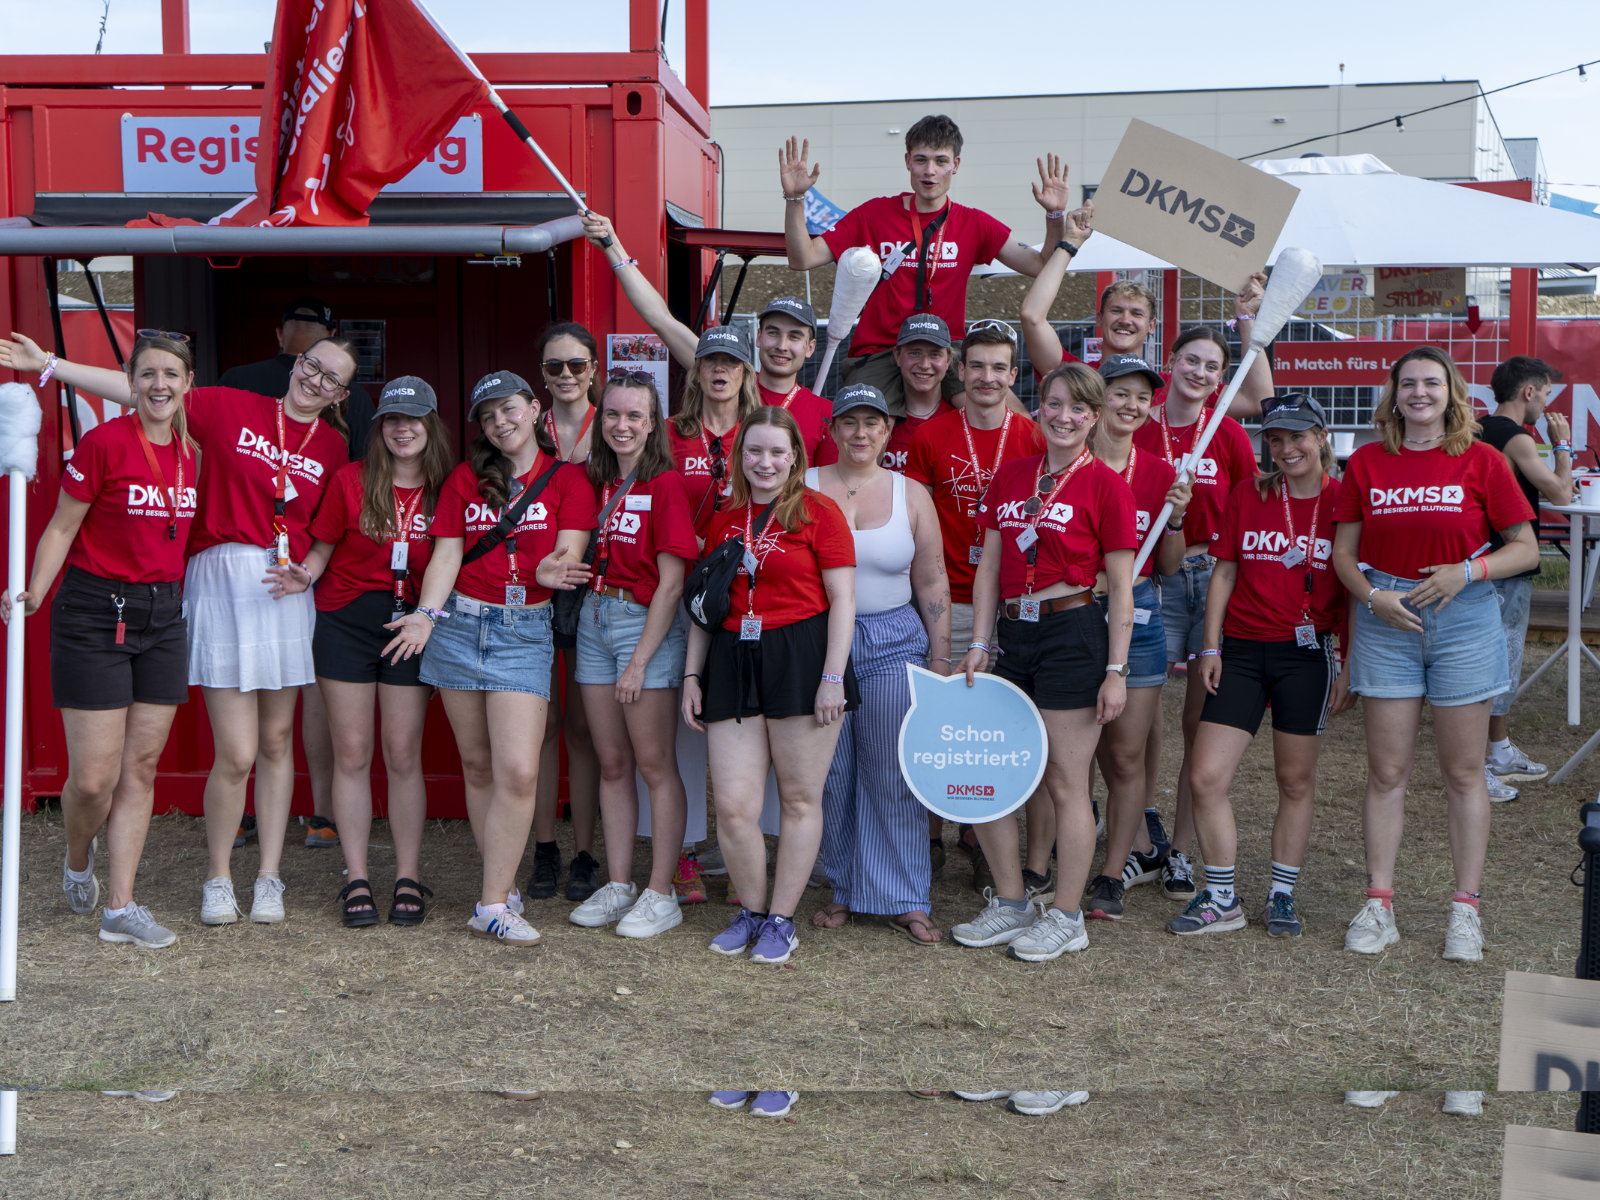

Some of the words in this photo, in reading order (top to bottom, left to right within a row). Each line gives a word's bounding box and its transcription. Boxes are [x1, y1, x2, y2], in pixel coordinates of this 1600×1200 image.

[1119, 168, 1226, 233] DKMS
[933, 234, 943, 253] besiegen
[1313, 277, 1364, 292] AVER
[1304, 297, 1329, 311] BE
[1383, 291, 1443, 308] STATION
[1444, 295, 1461, 307] DIY
[910, 322, 932, 330] DKMS
[707, 333, 731, 341] DKMS
[1294, 358, 1343, 370] Match
[1346, 357, 1378, 370] fürs
[384, 388, 407, 399] DKMS
[473, 381, 493, 399] DKMS
[844, 390, 869, 400] DKMS
[961, 418, 971, 435] besiegen
[1195, 417, 1204, 431] DKMS
[965, 434, 976, 453] Blutkrebs
[997, 429, 1006, 448] Blutkrebs
[237, 427, 304, 471] DKMS
[993, 448, 1002, 466] besiegen
[236, 446, 251, 456] WIR
[288, 468, 320, 485] LUTKREBS
[970, 453, 980, 468] DKMS
[1053, 470, 1070, 490] Blutkrebs
[1067, 458, 1080, 472] DKMS
[1281, 487, 1289, 501] DKMS
[1370, 486, 1441, 507] DKMS
[127, 508, 144, 516] WIR
[404, 503, 415, 521] besiegen
[1284, 501, 1292, 521] Blutkrebs
[1383, 506, 1419, 514] BESIEGEN
[1421, 505, 1462, 513] BLUTKREBS
[514, 523, 548, 533] LUTKREBS
[1288, 520, 1296, 539] besiegen
[1242, 530, 1309, 554] DKMS
[940, 724, 1005, 743] Schon
[913, 747, 1031, 769] registriert?
[947, 784, 983, 796] DKMS
